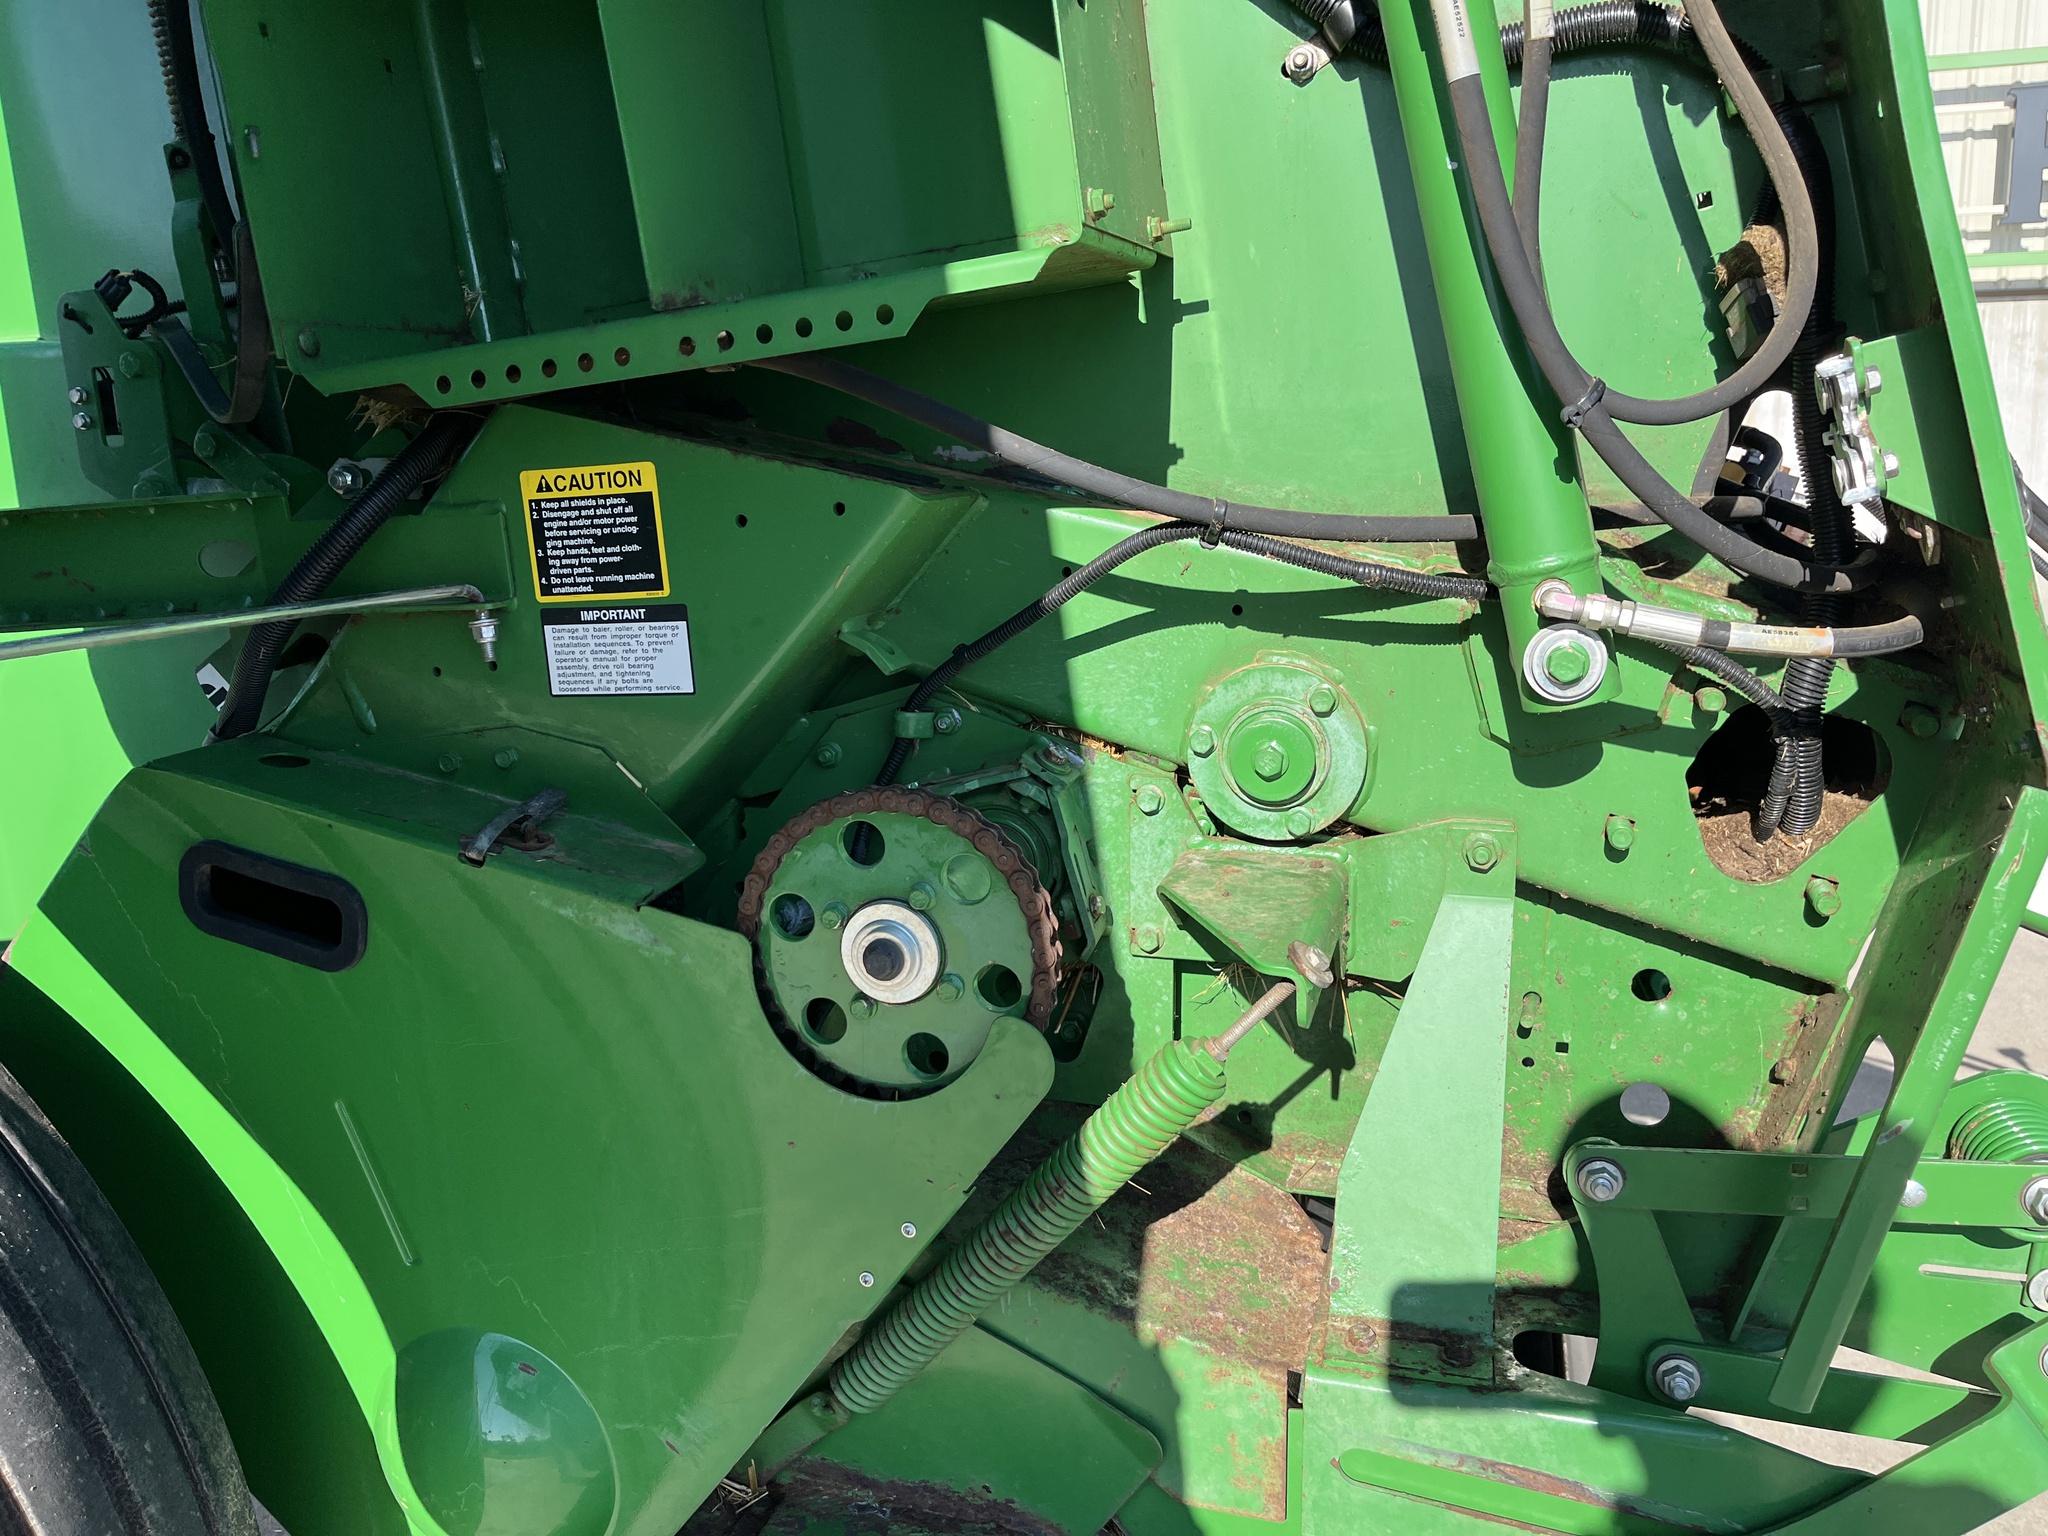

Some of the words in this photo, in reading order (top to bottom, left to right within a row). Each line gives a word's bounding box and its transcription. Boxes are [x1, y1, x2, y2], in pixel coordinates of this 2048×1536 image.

[554, 469, 642, 492] CAUTION
[541, 501, 559, 510] Keep
[571, 498, 596, 507] shields
[606, 497, 628, 506] place.
[542, 510, 579, 518] Disengage
[596, 507, 612, 515] shut
[613, 506, 623, 514] off
[544, 520, 568, 528] engine
[569, 518, 592, 526] and/or
[616, 516, 638, 525] power
[569, 527, 601, 536] servicing
[612, 525, 639, 534] unclog-
[546, 539, 562, 548] ging
[563, 537, 596, 545] machine.
[547, 548, 565, 557] Keep
[566, 547, 591, 555] hands,
[607, 545, 620, 553] and
[621, 544, 642, 552] cloth-
[548, 558, 560, 566] ing
[599, 556, 623, 564] power-
[573, 566, 594, 575] parts.
[596, 574, 623, 582] running
[624, 572, 655, 580] machine
[552, 585, 594, 593] unattended.
[580, 608, 646, 621] IMPORTANT
